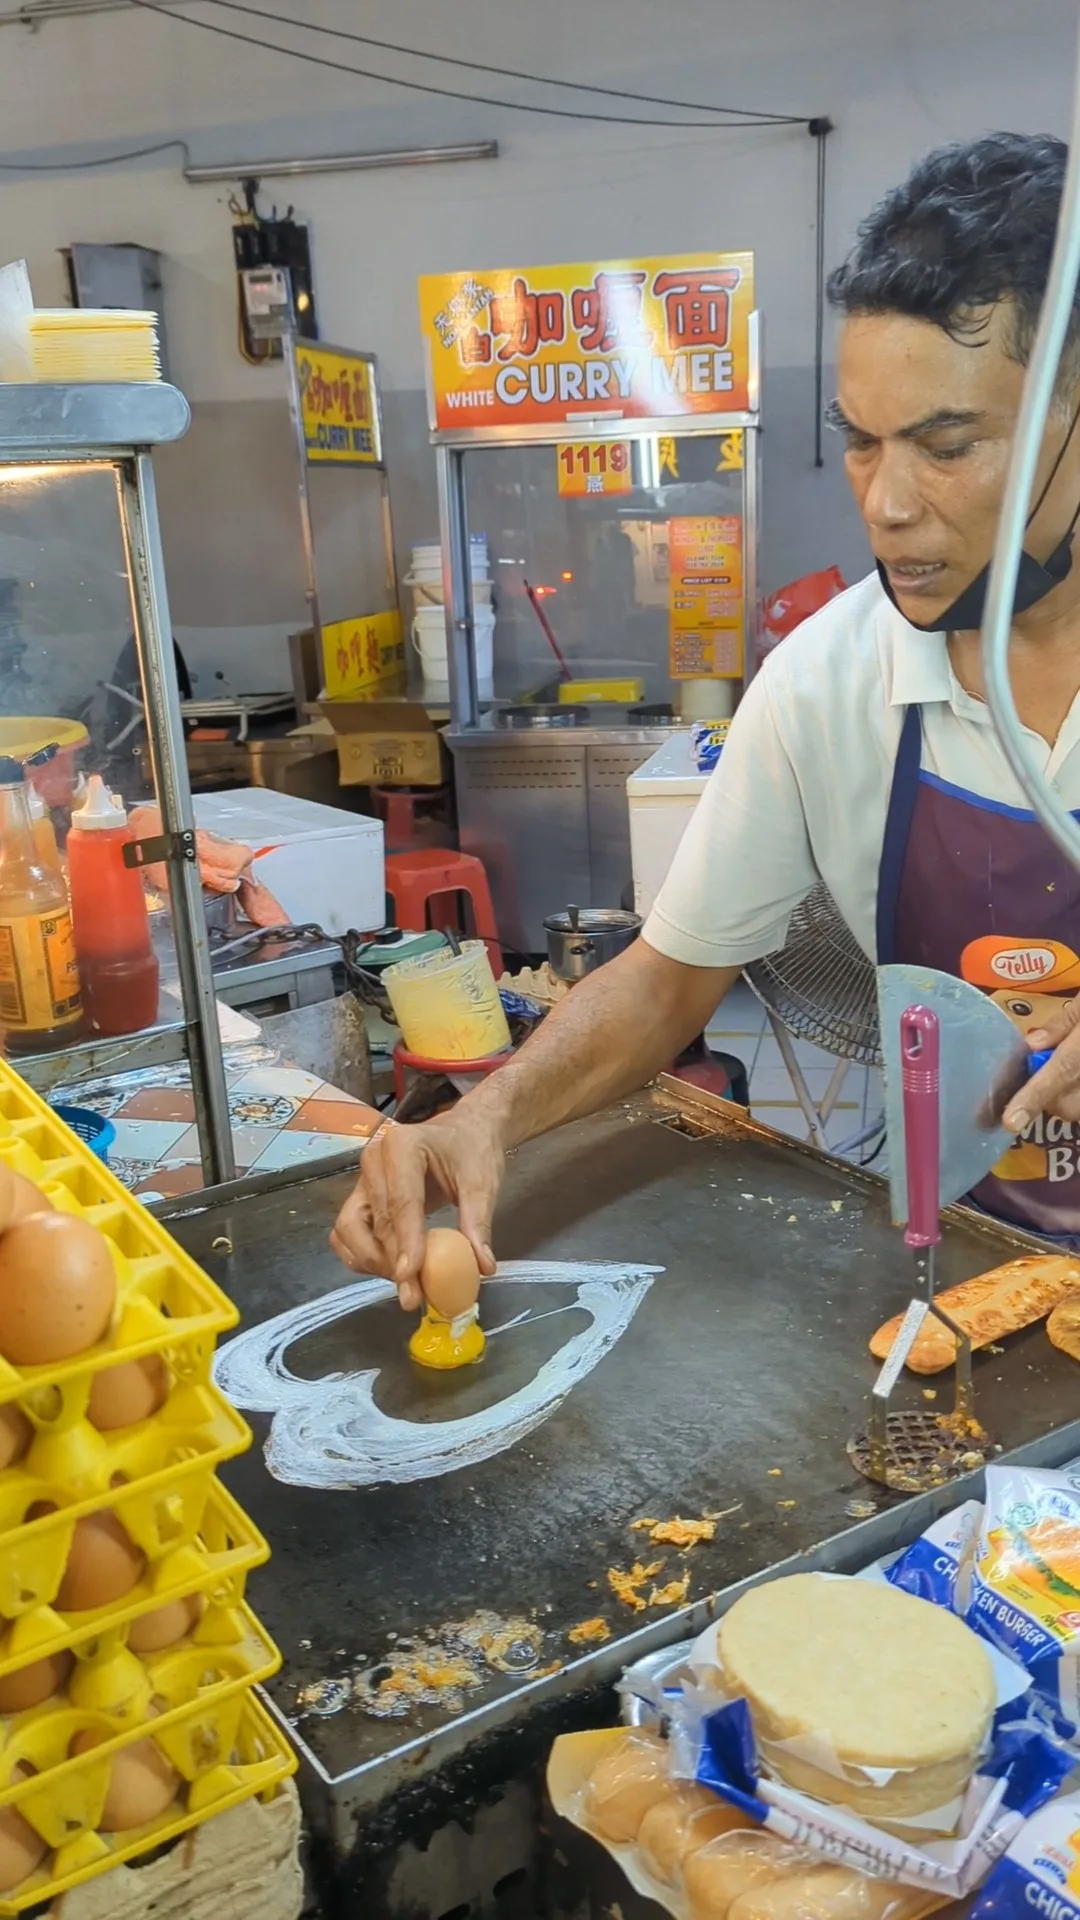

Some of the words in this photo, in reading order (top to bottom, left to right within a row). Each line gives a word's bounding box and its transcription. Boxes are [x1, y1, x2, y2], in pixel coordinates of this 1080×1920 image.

[446, 389, 495, 408] WHITE
[496, 358, 636, 404] CURRY
[652, 351, 734, 395] MEE
[560, 443, 629, 474] 1119
[995, 952, 1048, 978] Telly
[995, 1605, 1047, 1647] BURGER
[1025, 1881, 1080, 1920] CHIC
